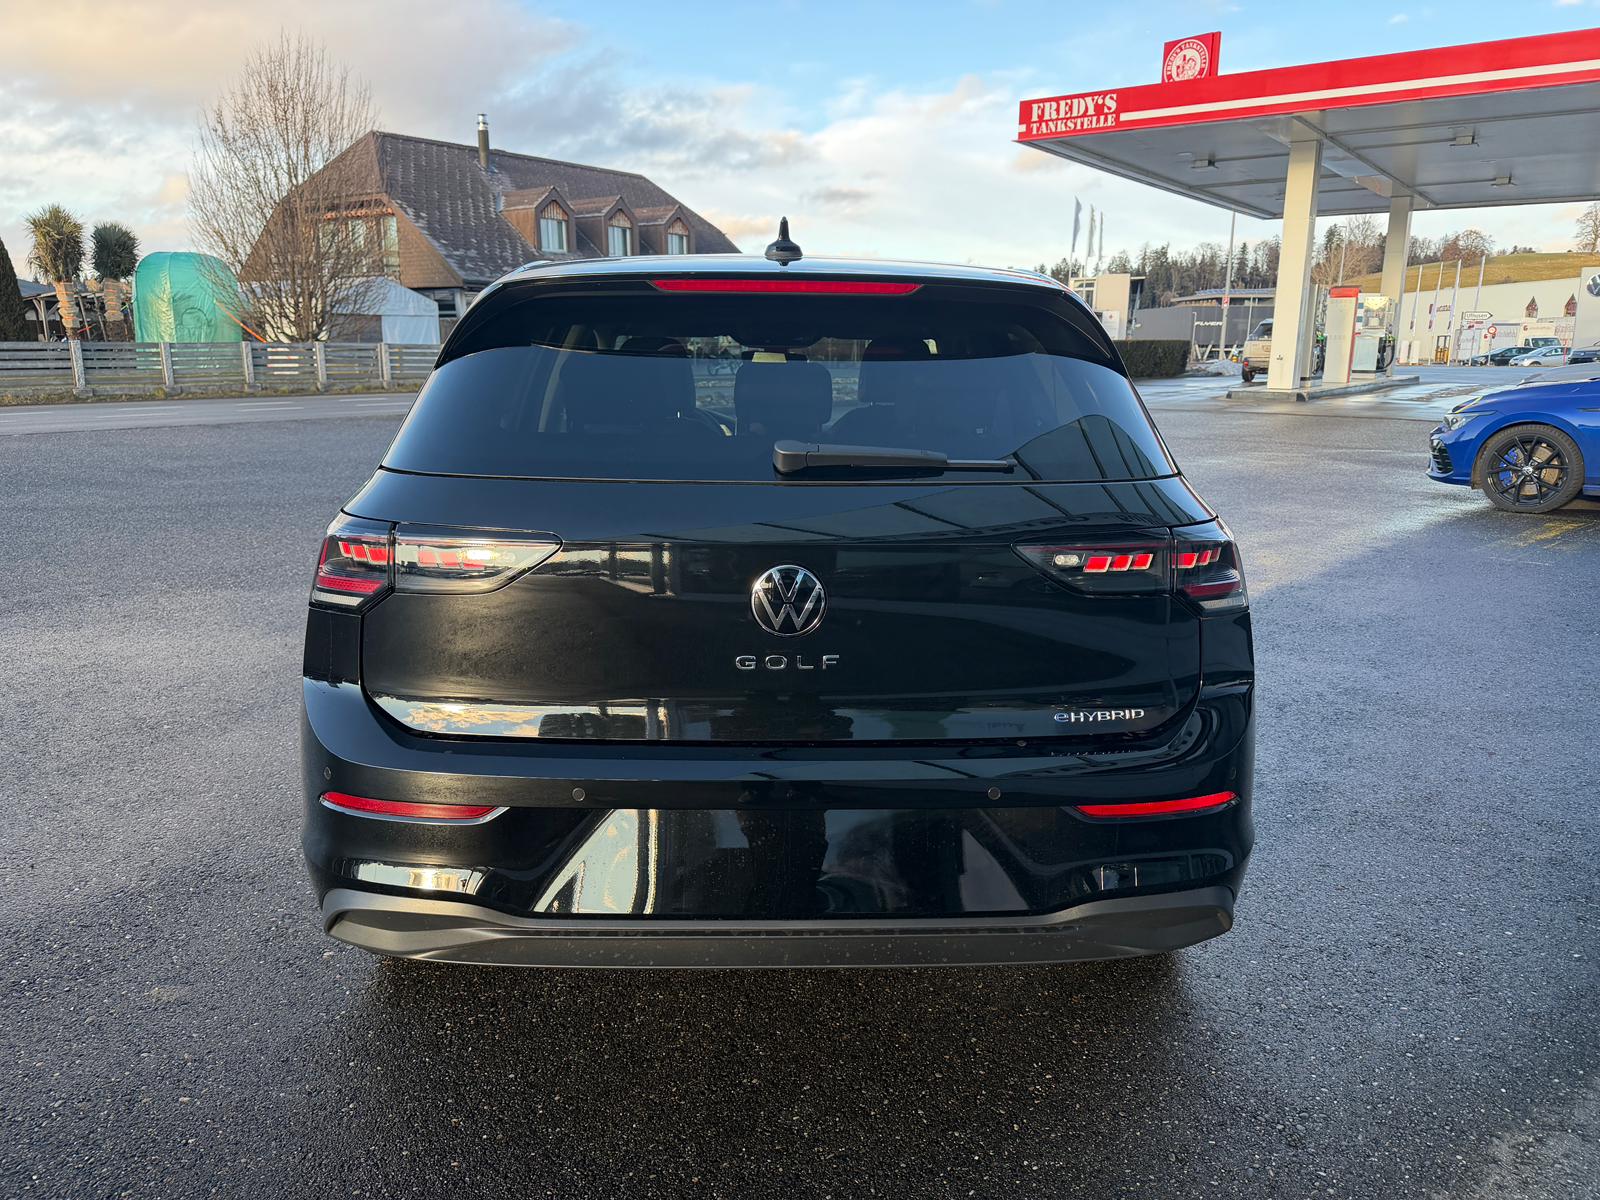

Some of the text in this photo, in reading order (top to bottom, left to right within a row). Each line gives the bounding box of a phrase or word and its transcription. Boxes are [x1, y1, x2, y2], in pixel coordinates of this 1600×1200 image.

[1181, 42, 1206, 68] TANKSTELLE
[1031, 94, 1117, 122] FREDY'S
[1031, 114, 1116, 135] TANKSTELLE
[735, 655, 840, 670] GOLF
[1054, 709, 1145, 722] eHYBRID
